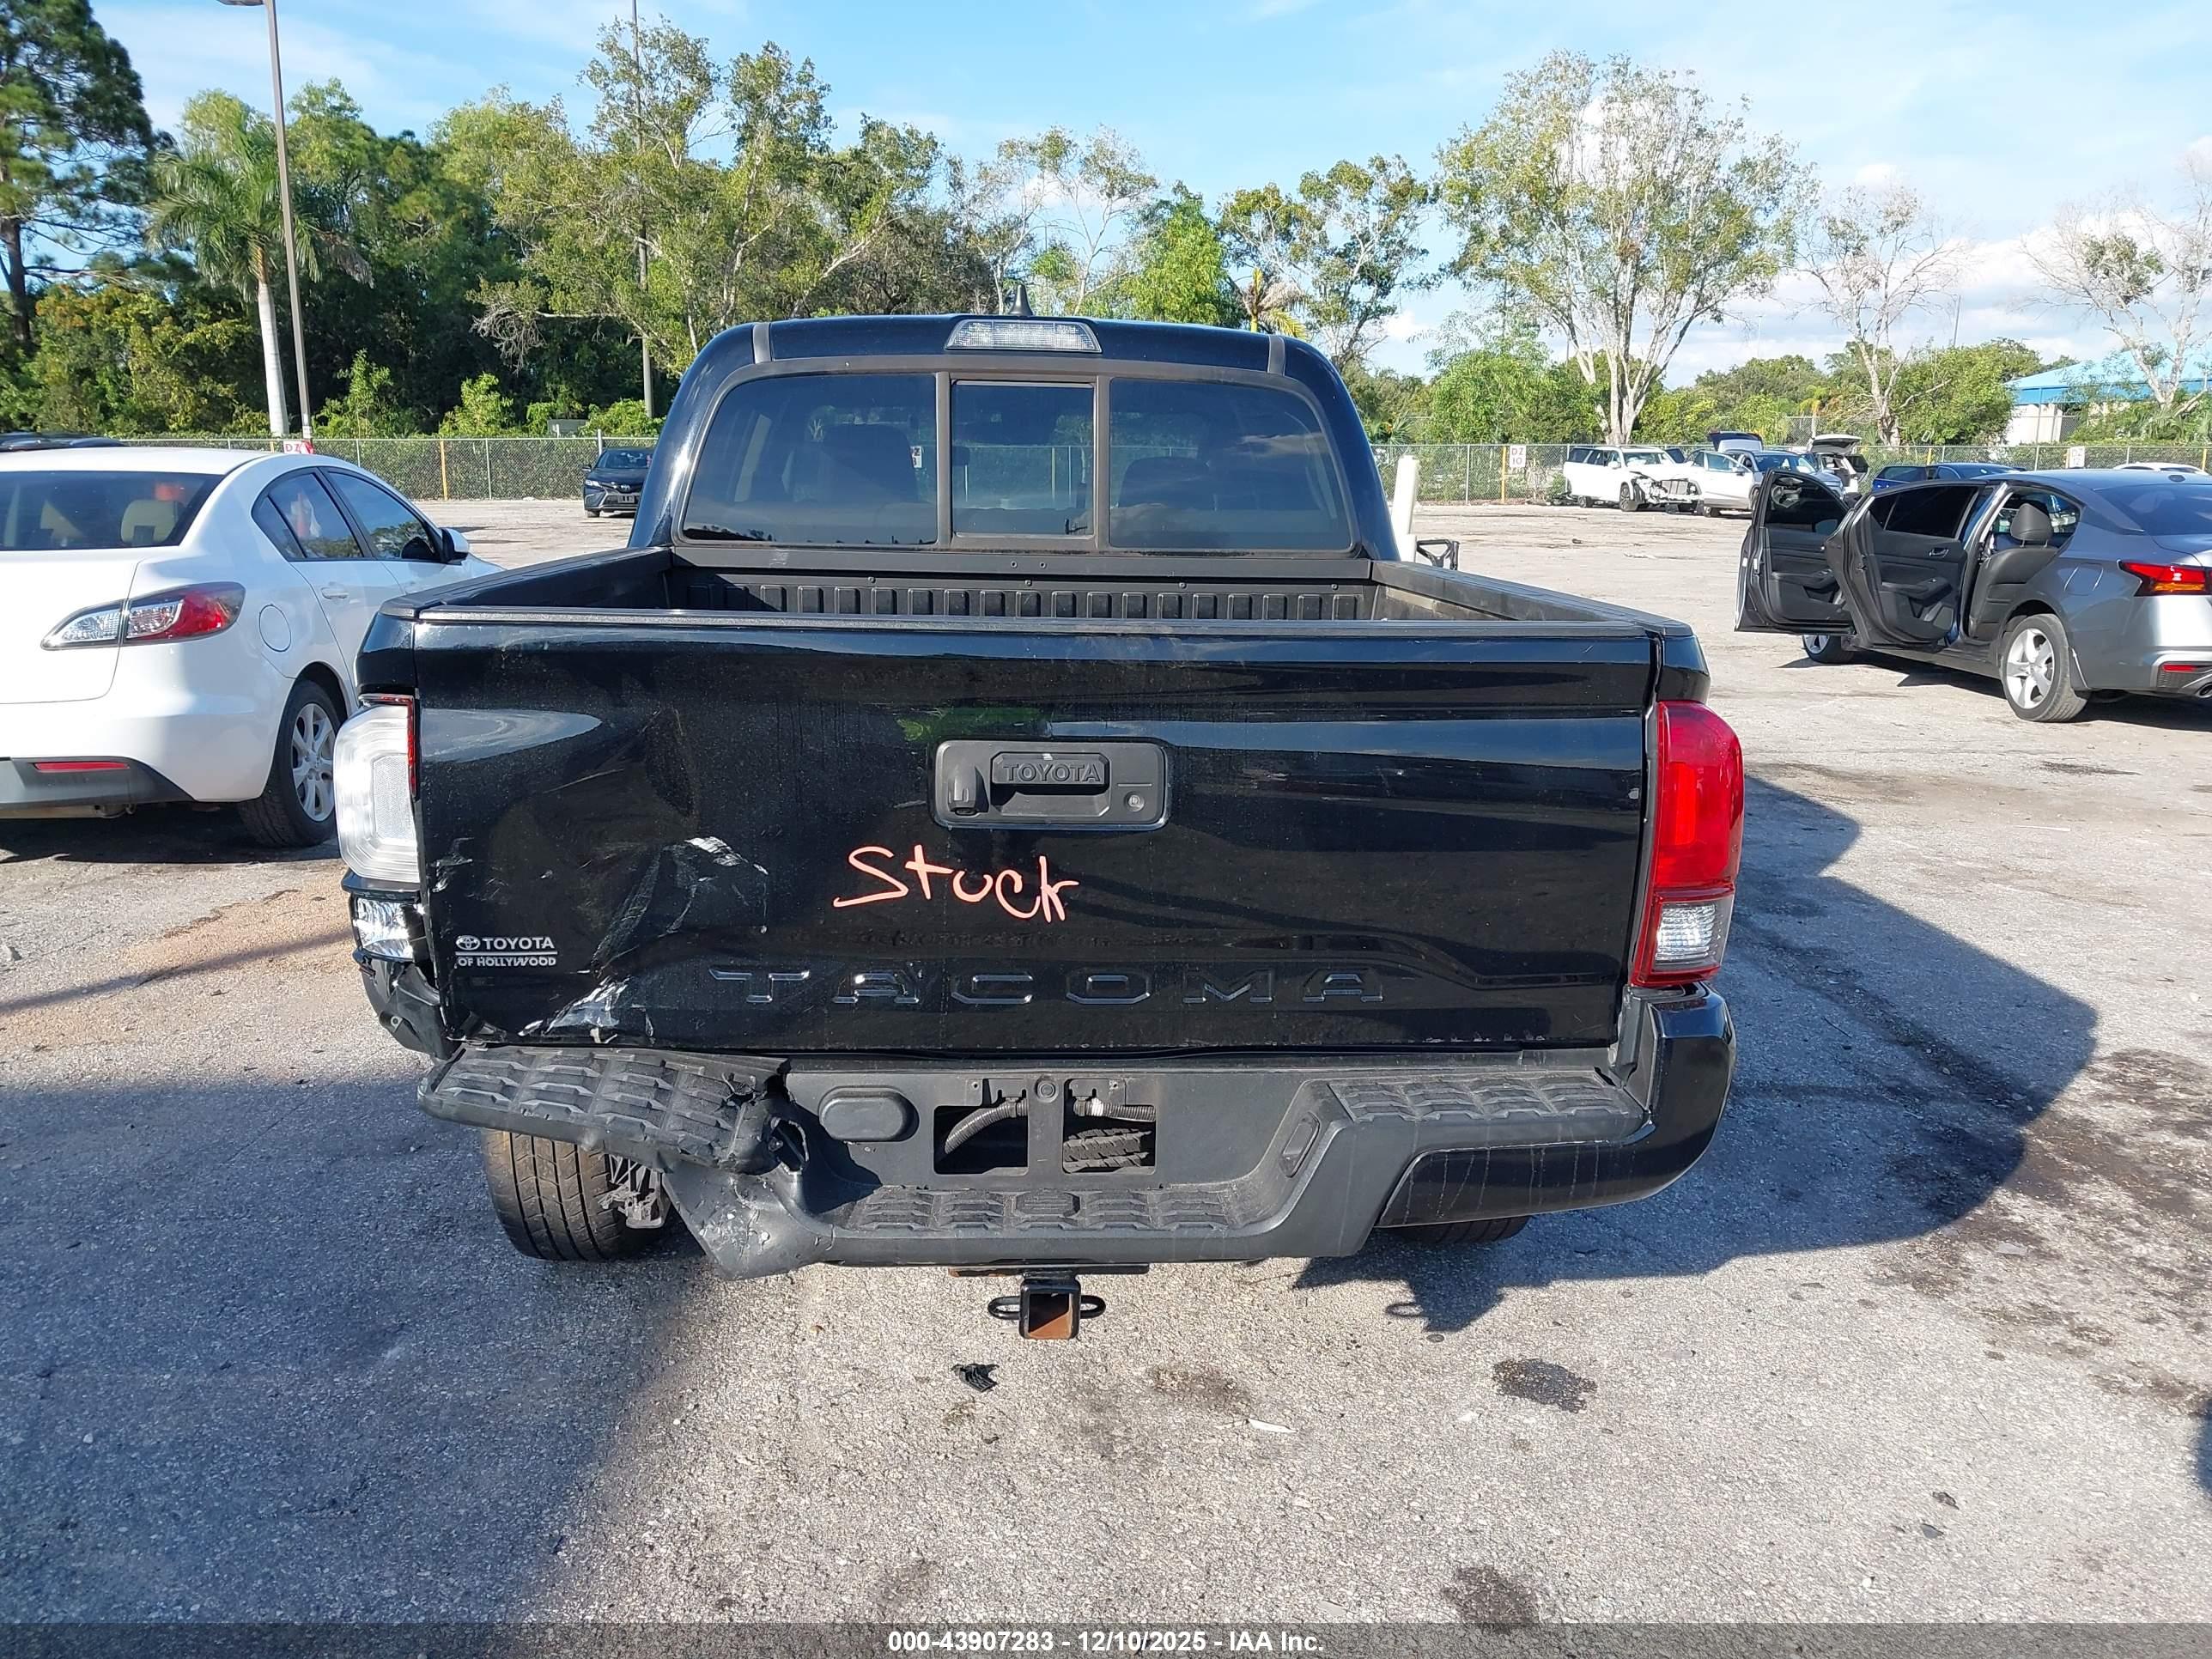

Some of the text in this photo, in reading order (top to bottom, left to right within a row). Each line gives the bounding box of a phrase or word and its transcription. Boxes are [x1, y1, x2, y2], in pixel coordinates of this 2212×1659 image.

[1511, 447, 1524, 456] DZ
[1003, 763, 1101, 783] TOYOTA
[482, 936, 556, 951] TOYOTA
[458, 956, 556, 967] OF HOLLYWOOD
[708, 965, 1384, 1004] TACOMA
